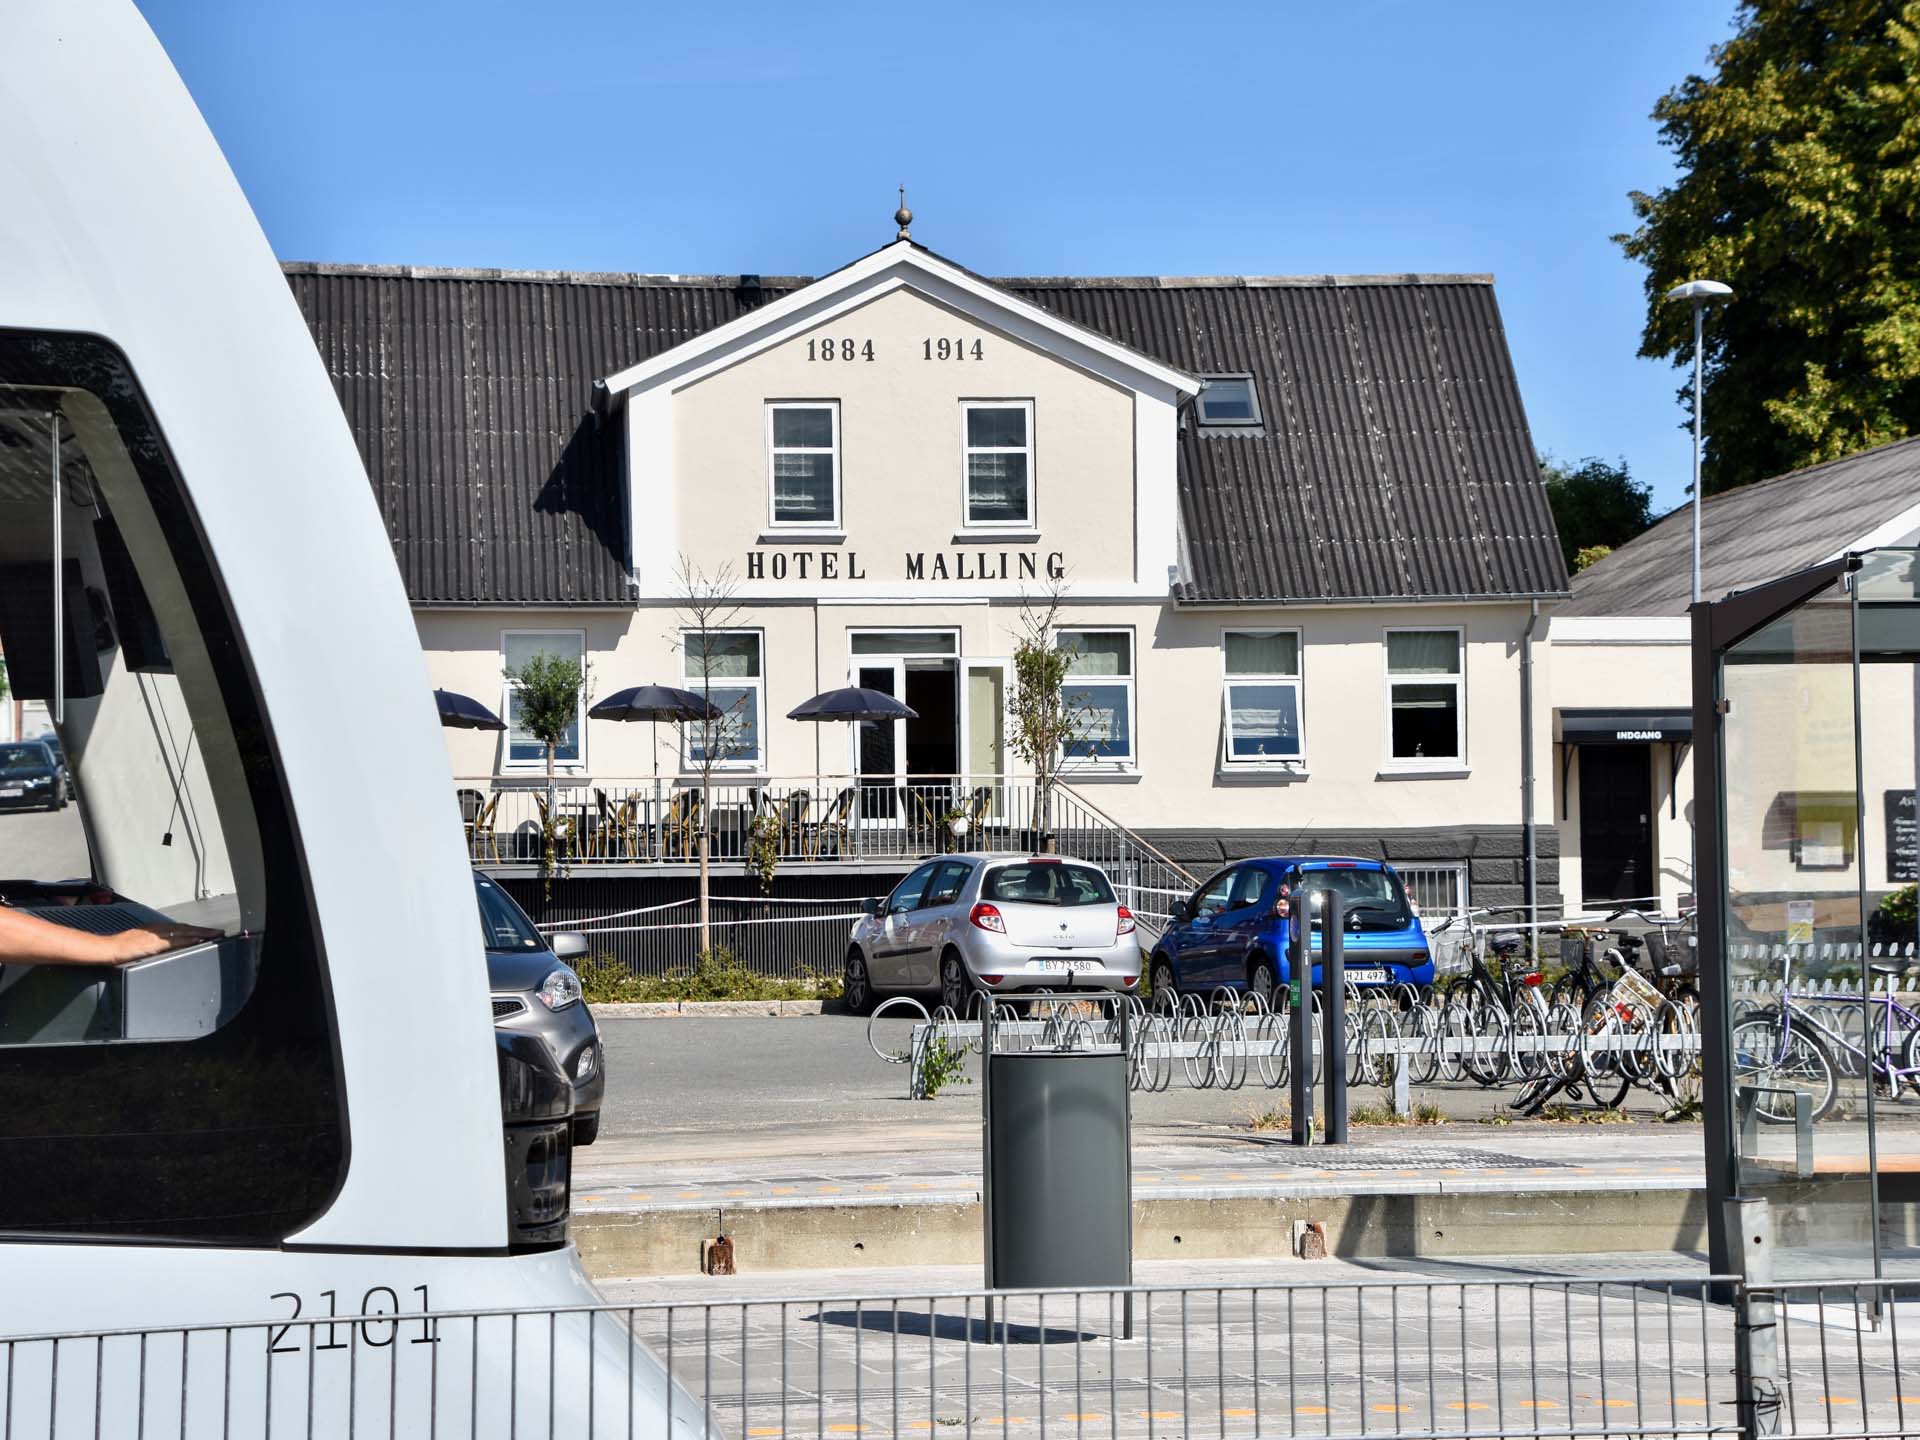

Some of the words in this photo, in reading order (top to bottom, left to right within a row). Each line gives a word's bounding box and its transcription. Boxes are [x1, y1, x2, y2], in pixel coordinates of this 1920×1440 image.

[807, 338, 875, 362] 1884
[923, 337, 984, 361] 1914
[747, 551, 866, 580] HOTEL
[905, 551, 1065, 580] MALLING
[1616, 731, 1662, 740] INDGANG
[1073, 961, 1091, 971] 580
[1367, 971, 1384, 981] 497
[267, 1284, 441, 1354] 2101
